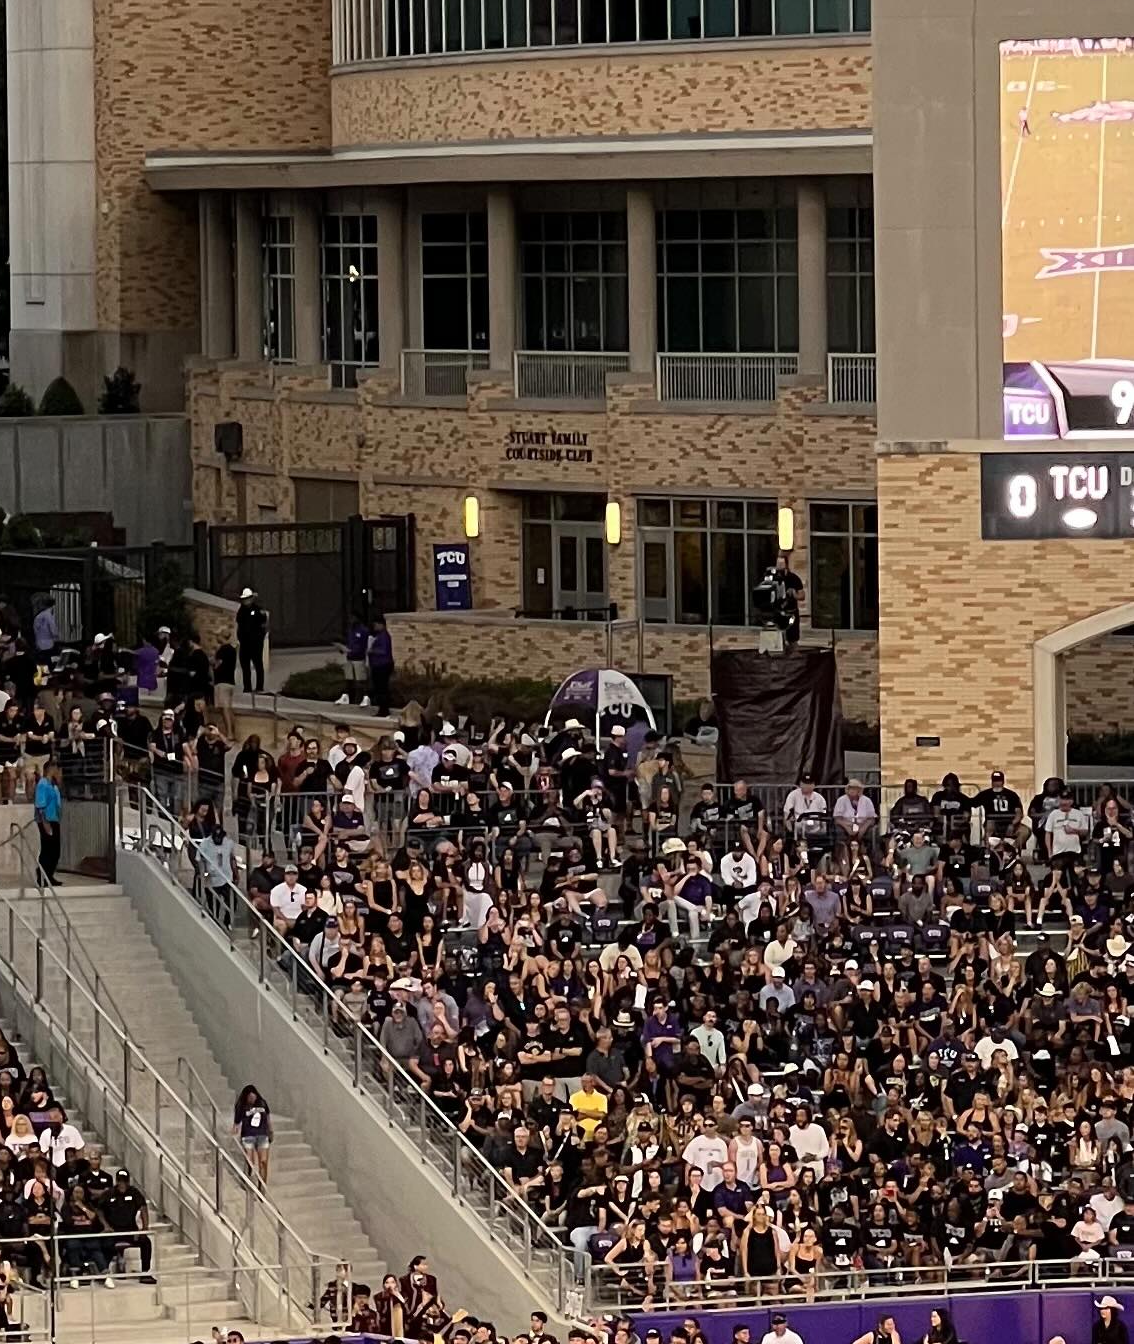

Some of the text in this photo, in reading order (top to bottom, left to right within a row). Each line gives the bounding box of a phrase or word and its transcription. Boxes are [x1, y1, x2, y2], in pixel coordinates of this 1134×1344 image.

[1009, 403, 1050, 425] TCU
[1008, 473, 1038, 519] 0
[1049, 465, 1109, 500] TCU
[436, 551, 466, 566] TCU
[994, 799, 1009, 812] 10
[939, 1048, 958, 1060] TCU
